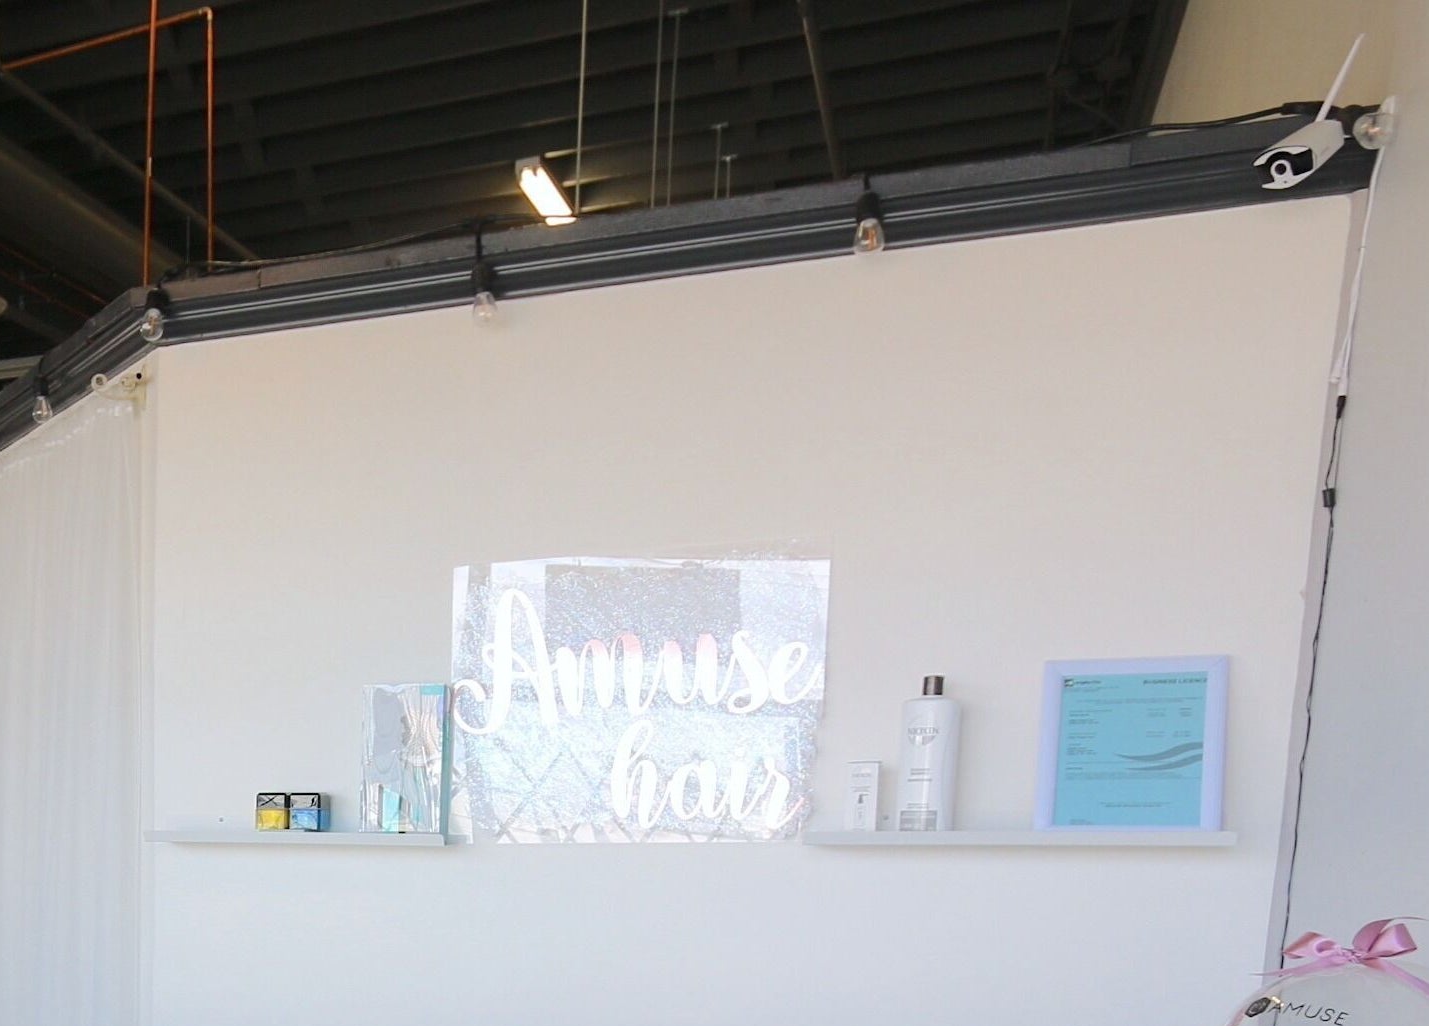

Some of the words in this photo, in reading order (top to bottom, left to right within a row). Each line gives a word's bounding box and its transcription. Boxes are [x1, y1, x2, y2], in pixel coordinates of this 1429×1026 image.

[454, 588, 824, 735] Amuse
[611, 719, 805, 830] hair
[1268, 1002, 1349, 1026] AMUSE
